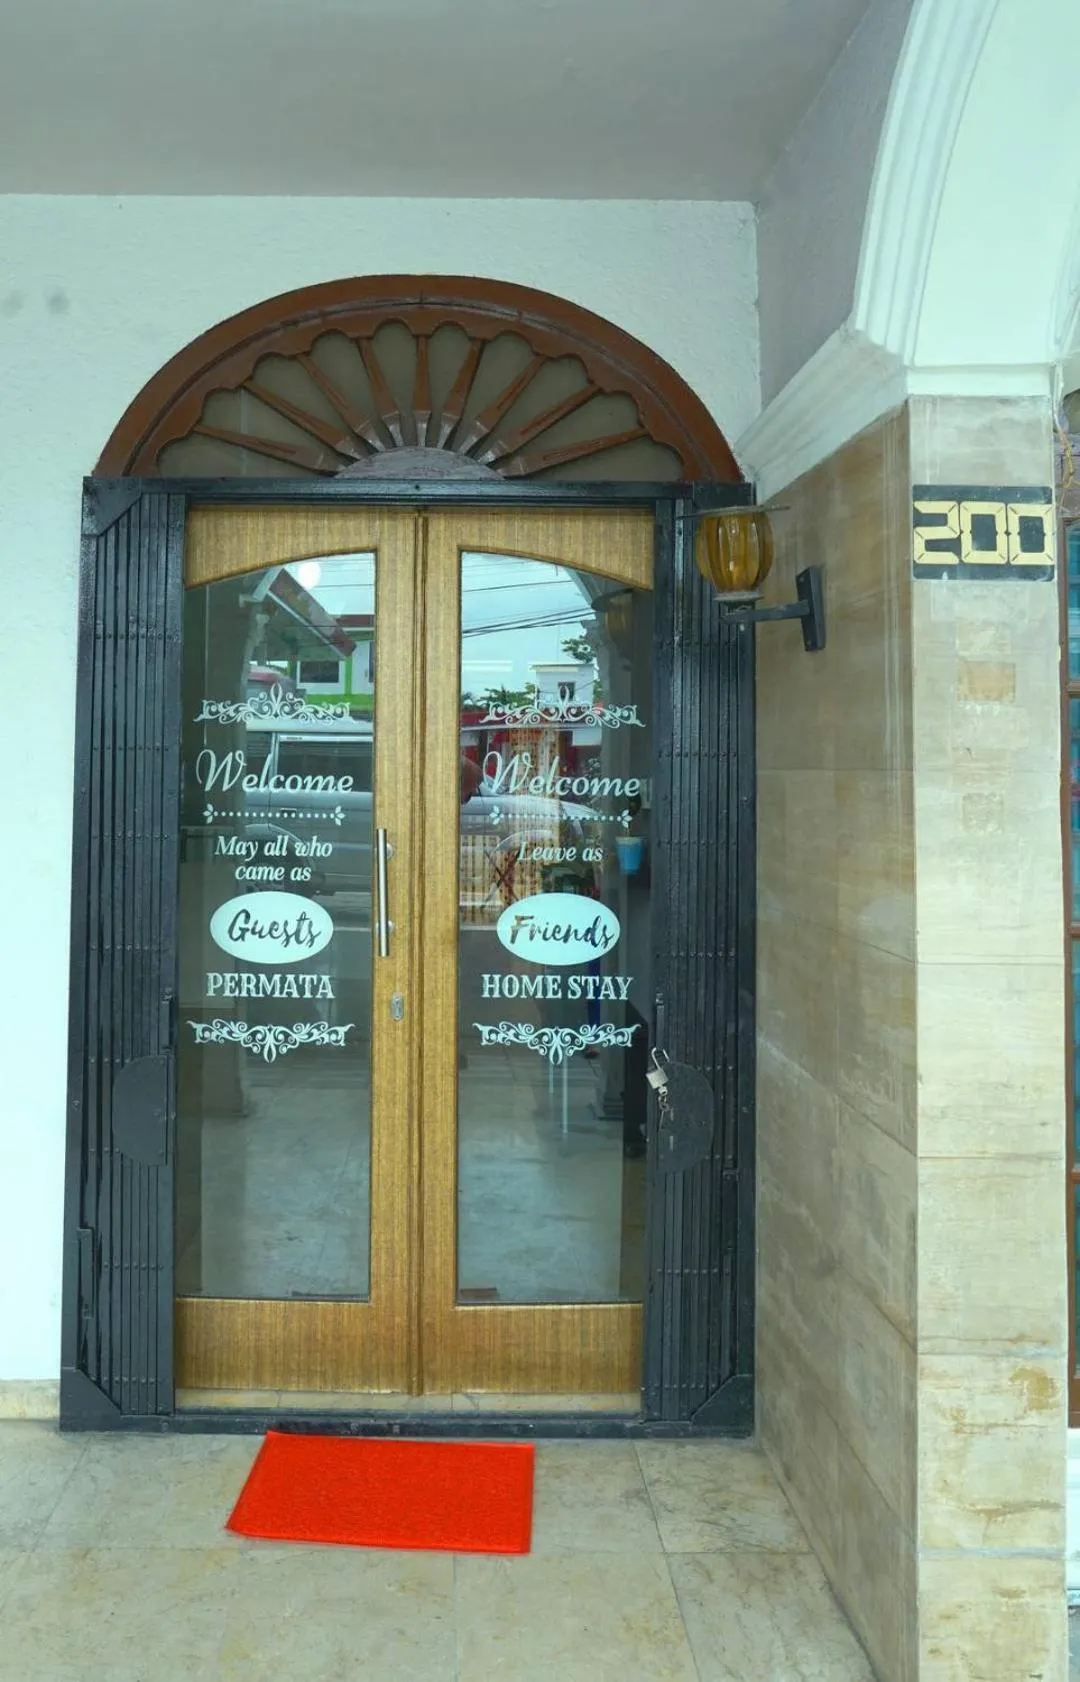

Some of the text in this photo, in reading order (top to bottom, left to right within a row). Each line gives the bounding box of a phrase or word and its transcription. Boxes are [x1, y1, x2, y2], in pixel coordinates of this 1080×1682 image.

[913, 500, 1055, 566] 200
[196, 749, 354, 793] Welcome
[482, 750, 642, 797] Welcome
[214, 834, 333, 862] May all who
[516, 841, 604, 862] Leave as
[235, 865, 312, 881] came as
[227, 908, 322, 948] Guests
[509, 915, 615, 949] Friends
[205, 972, 336, 999] PERMATA
[480, 973, 635, 1001] HOME STAY
